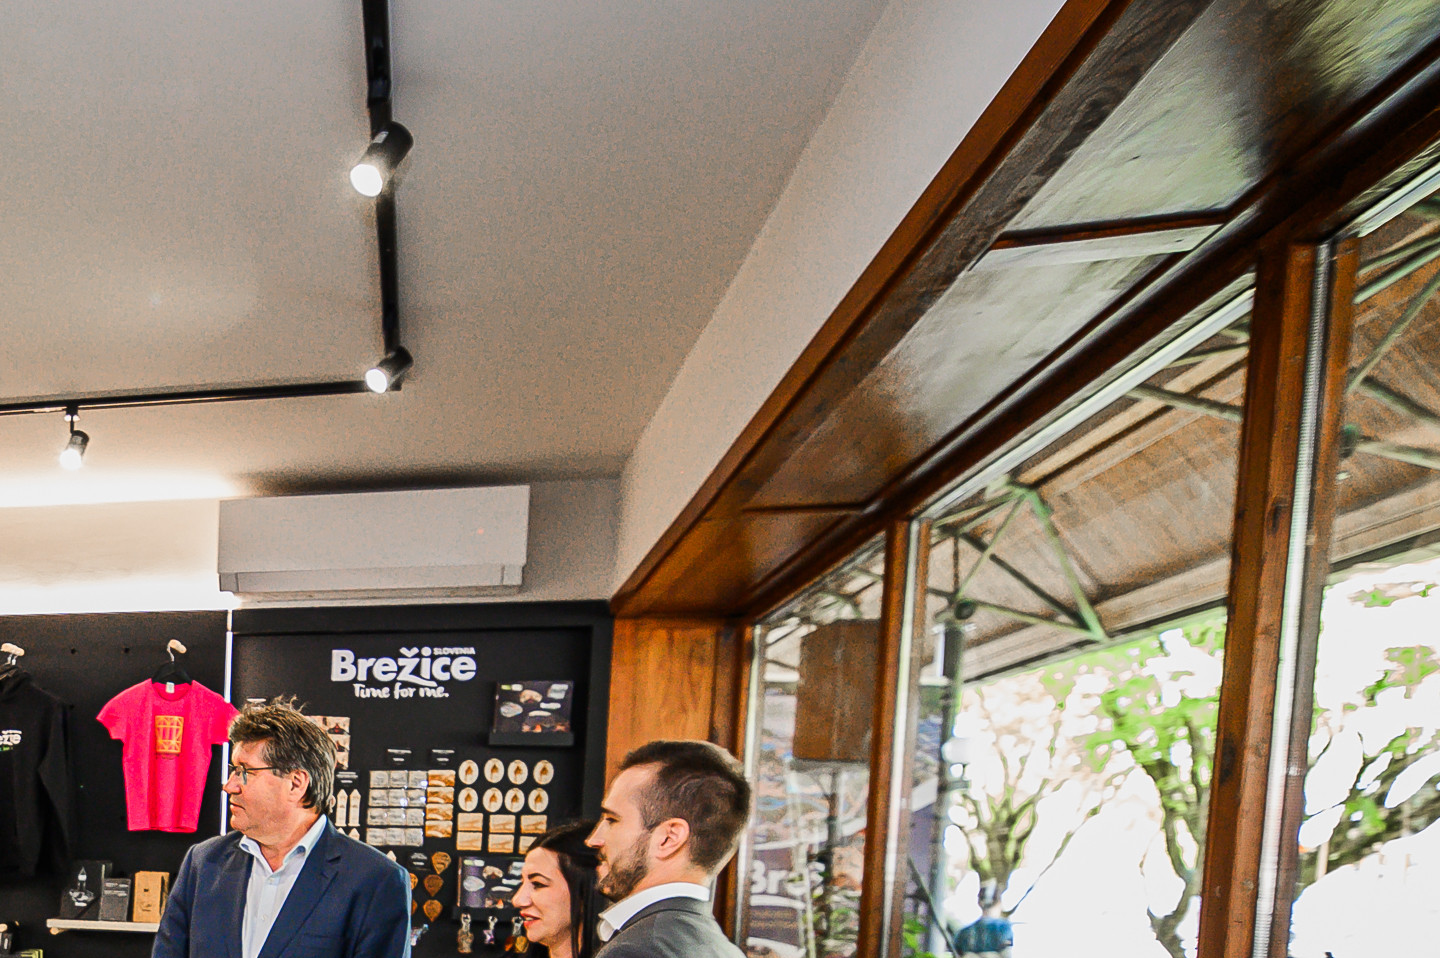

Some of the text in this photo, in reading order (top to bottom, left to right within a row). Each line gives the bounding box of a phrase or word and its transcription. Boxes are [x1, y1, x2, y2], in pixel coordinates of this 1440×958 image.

[433, 646, 476, 655] SLOVENIA
[331, 647, 477, 687] Brežice
[353, 682, 450, 700] Time for me.
